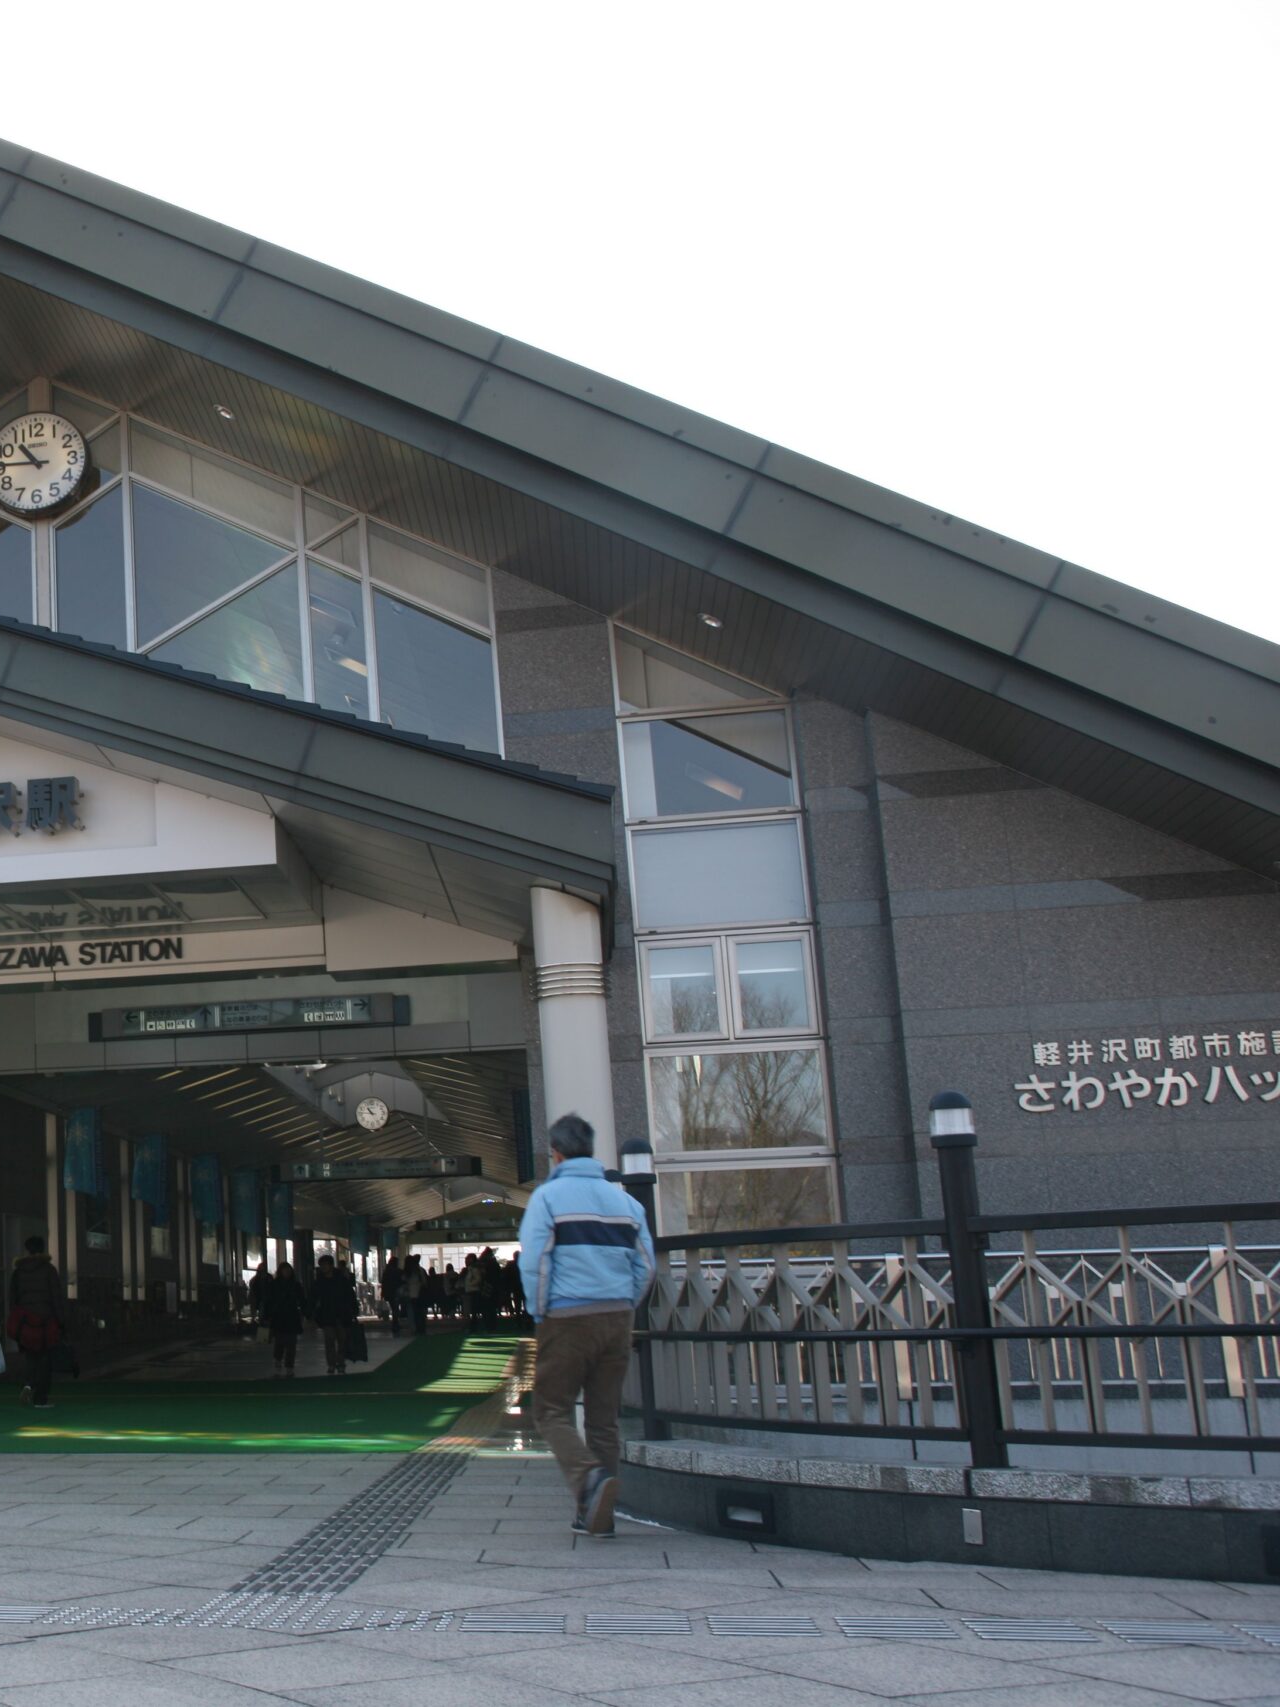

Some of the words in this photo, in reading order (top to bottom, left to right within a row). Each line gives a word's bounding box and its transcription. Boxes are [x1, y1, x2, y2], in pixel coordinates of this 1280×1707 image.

[14, 429, 26, 443] 11
[29, 422, 44, 438] 12
[52, 424, 56, 438] 1
[62, 434, 73, 449] 2
[0, 443, 14, 458] 10
[67, 450, 78, 465] 3
[62, 468, 73, 482] 4
[1, 476, 12, 491] 8
[49, 482, 60, 497] 5
[15, 488, 26, 502] 7
[31, 489, 42, 504] 6
[79, 937, 183, 966] STATION
